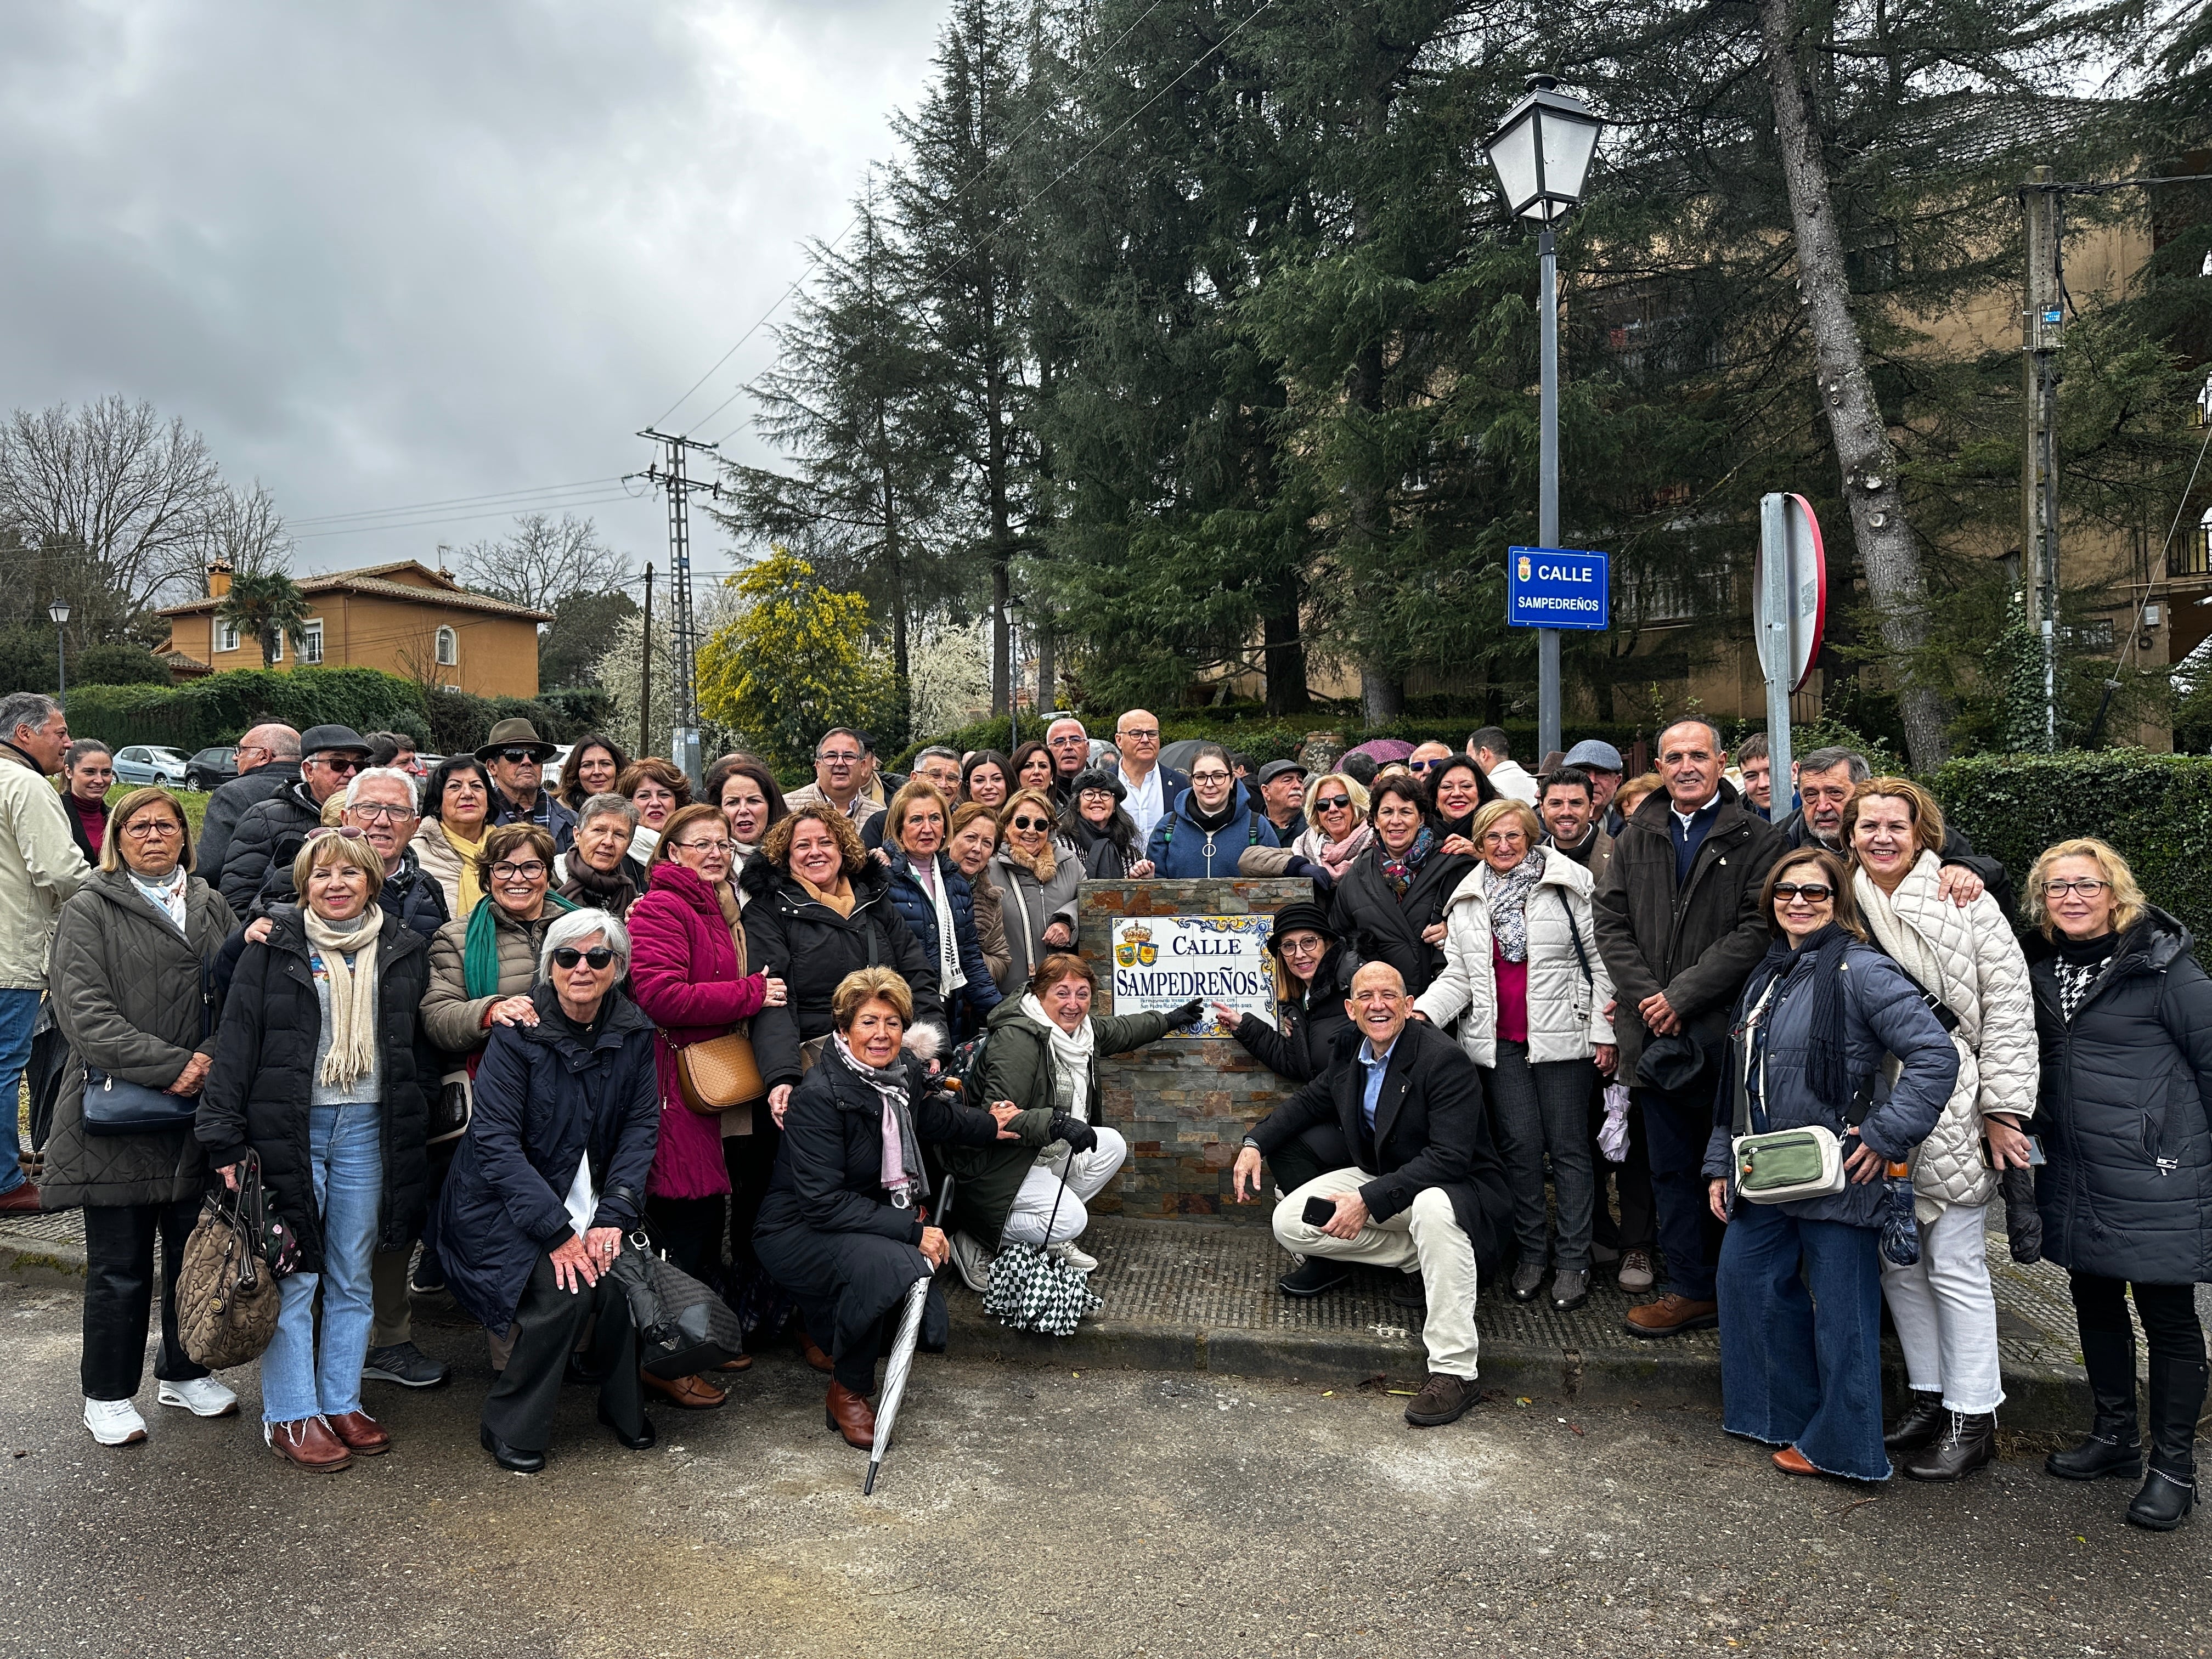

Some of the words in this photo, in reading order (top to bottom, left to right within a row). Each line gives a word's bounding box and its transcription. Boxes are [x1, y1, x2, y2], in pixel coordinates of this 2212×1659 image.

[1538, 565, 1593, 583] CALLE
[1518, 596, 1599, 611] SAMPEDREÑOS
[1172, 935, 1242, 955] CALLE
[1117, 967, 1258, 996] SAMPEDREÑOS
